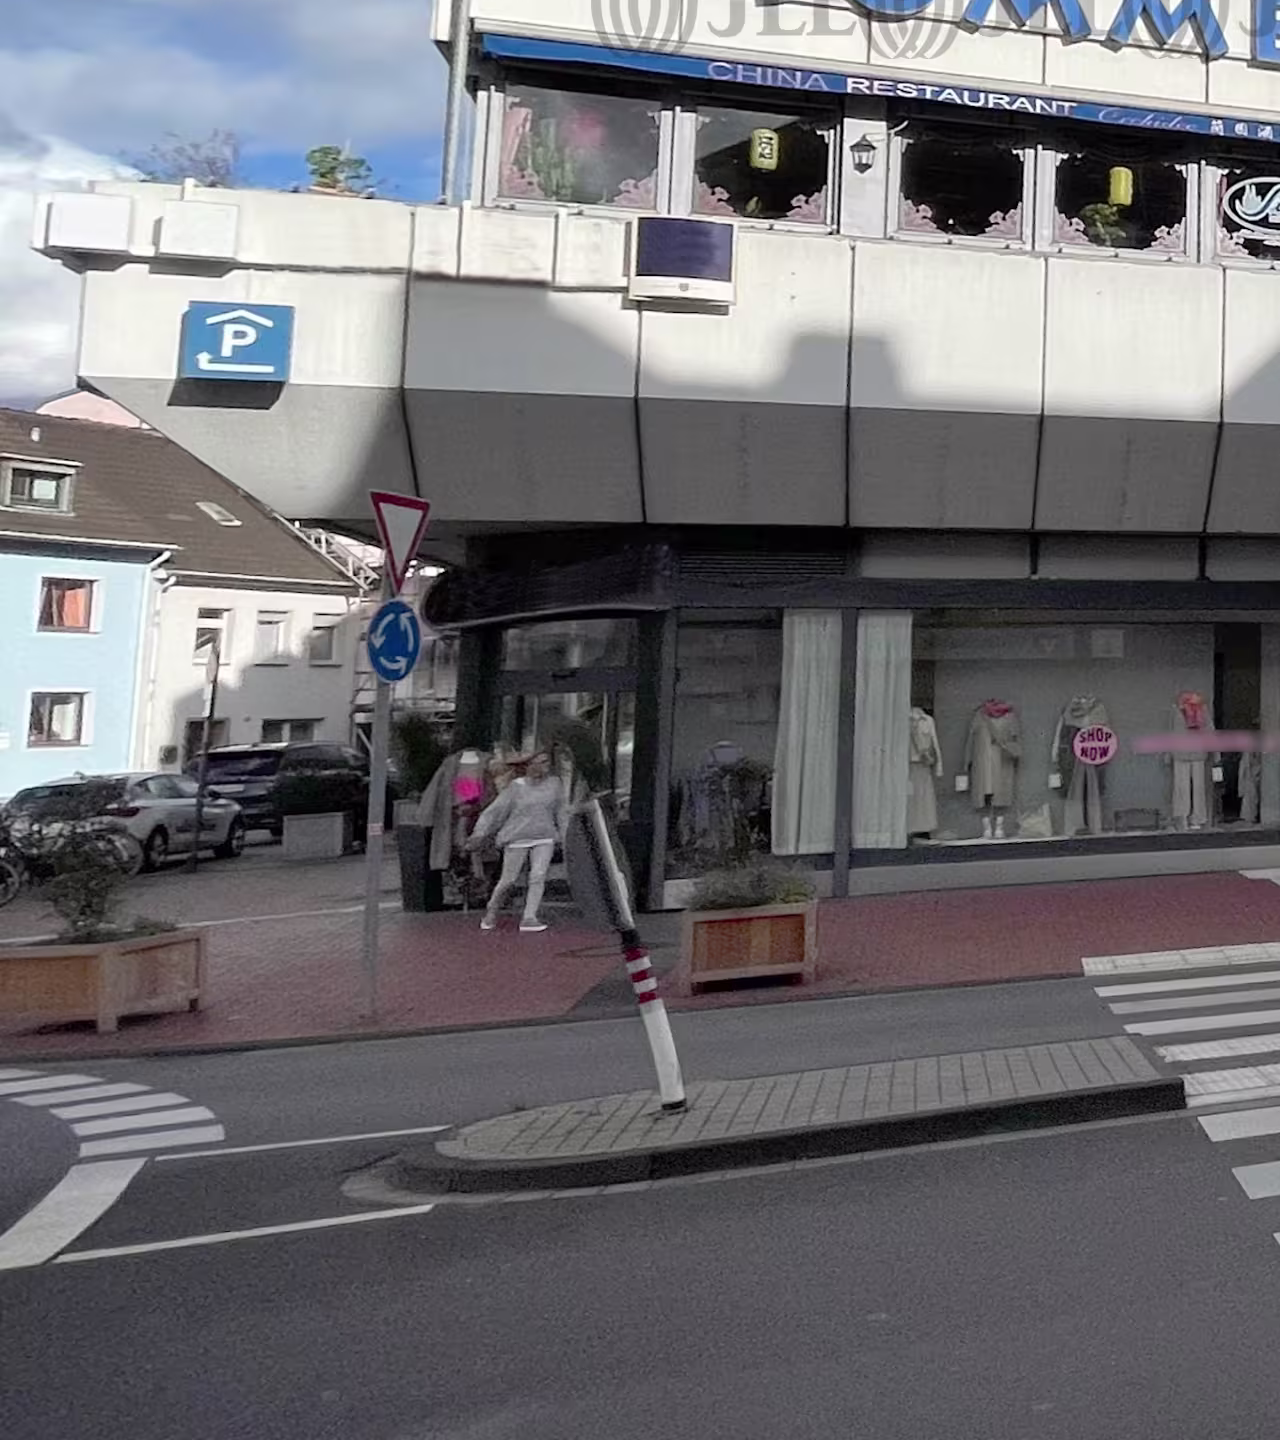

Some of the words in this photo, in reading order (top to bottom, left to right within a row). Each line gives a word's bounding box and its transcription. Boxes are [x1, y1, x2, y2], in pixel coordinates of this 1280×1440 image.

[707, 61, 828, 91] CHINA
[845, 76, 1079, 116] RESTAURANT
[221, 322, 257, 358] P
[1079, 727, 1112, 743] SHOP
[1080, 746, 1110, 761] NOW
